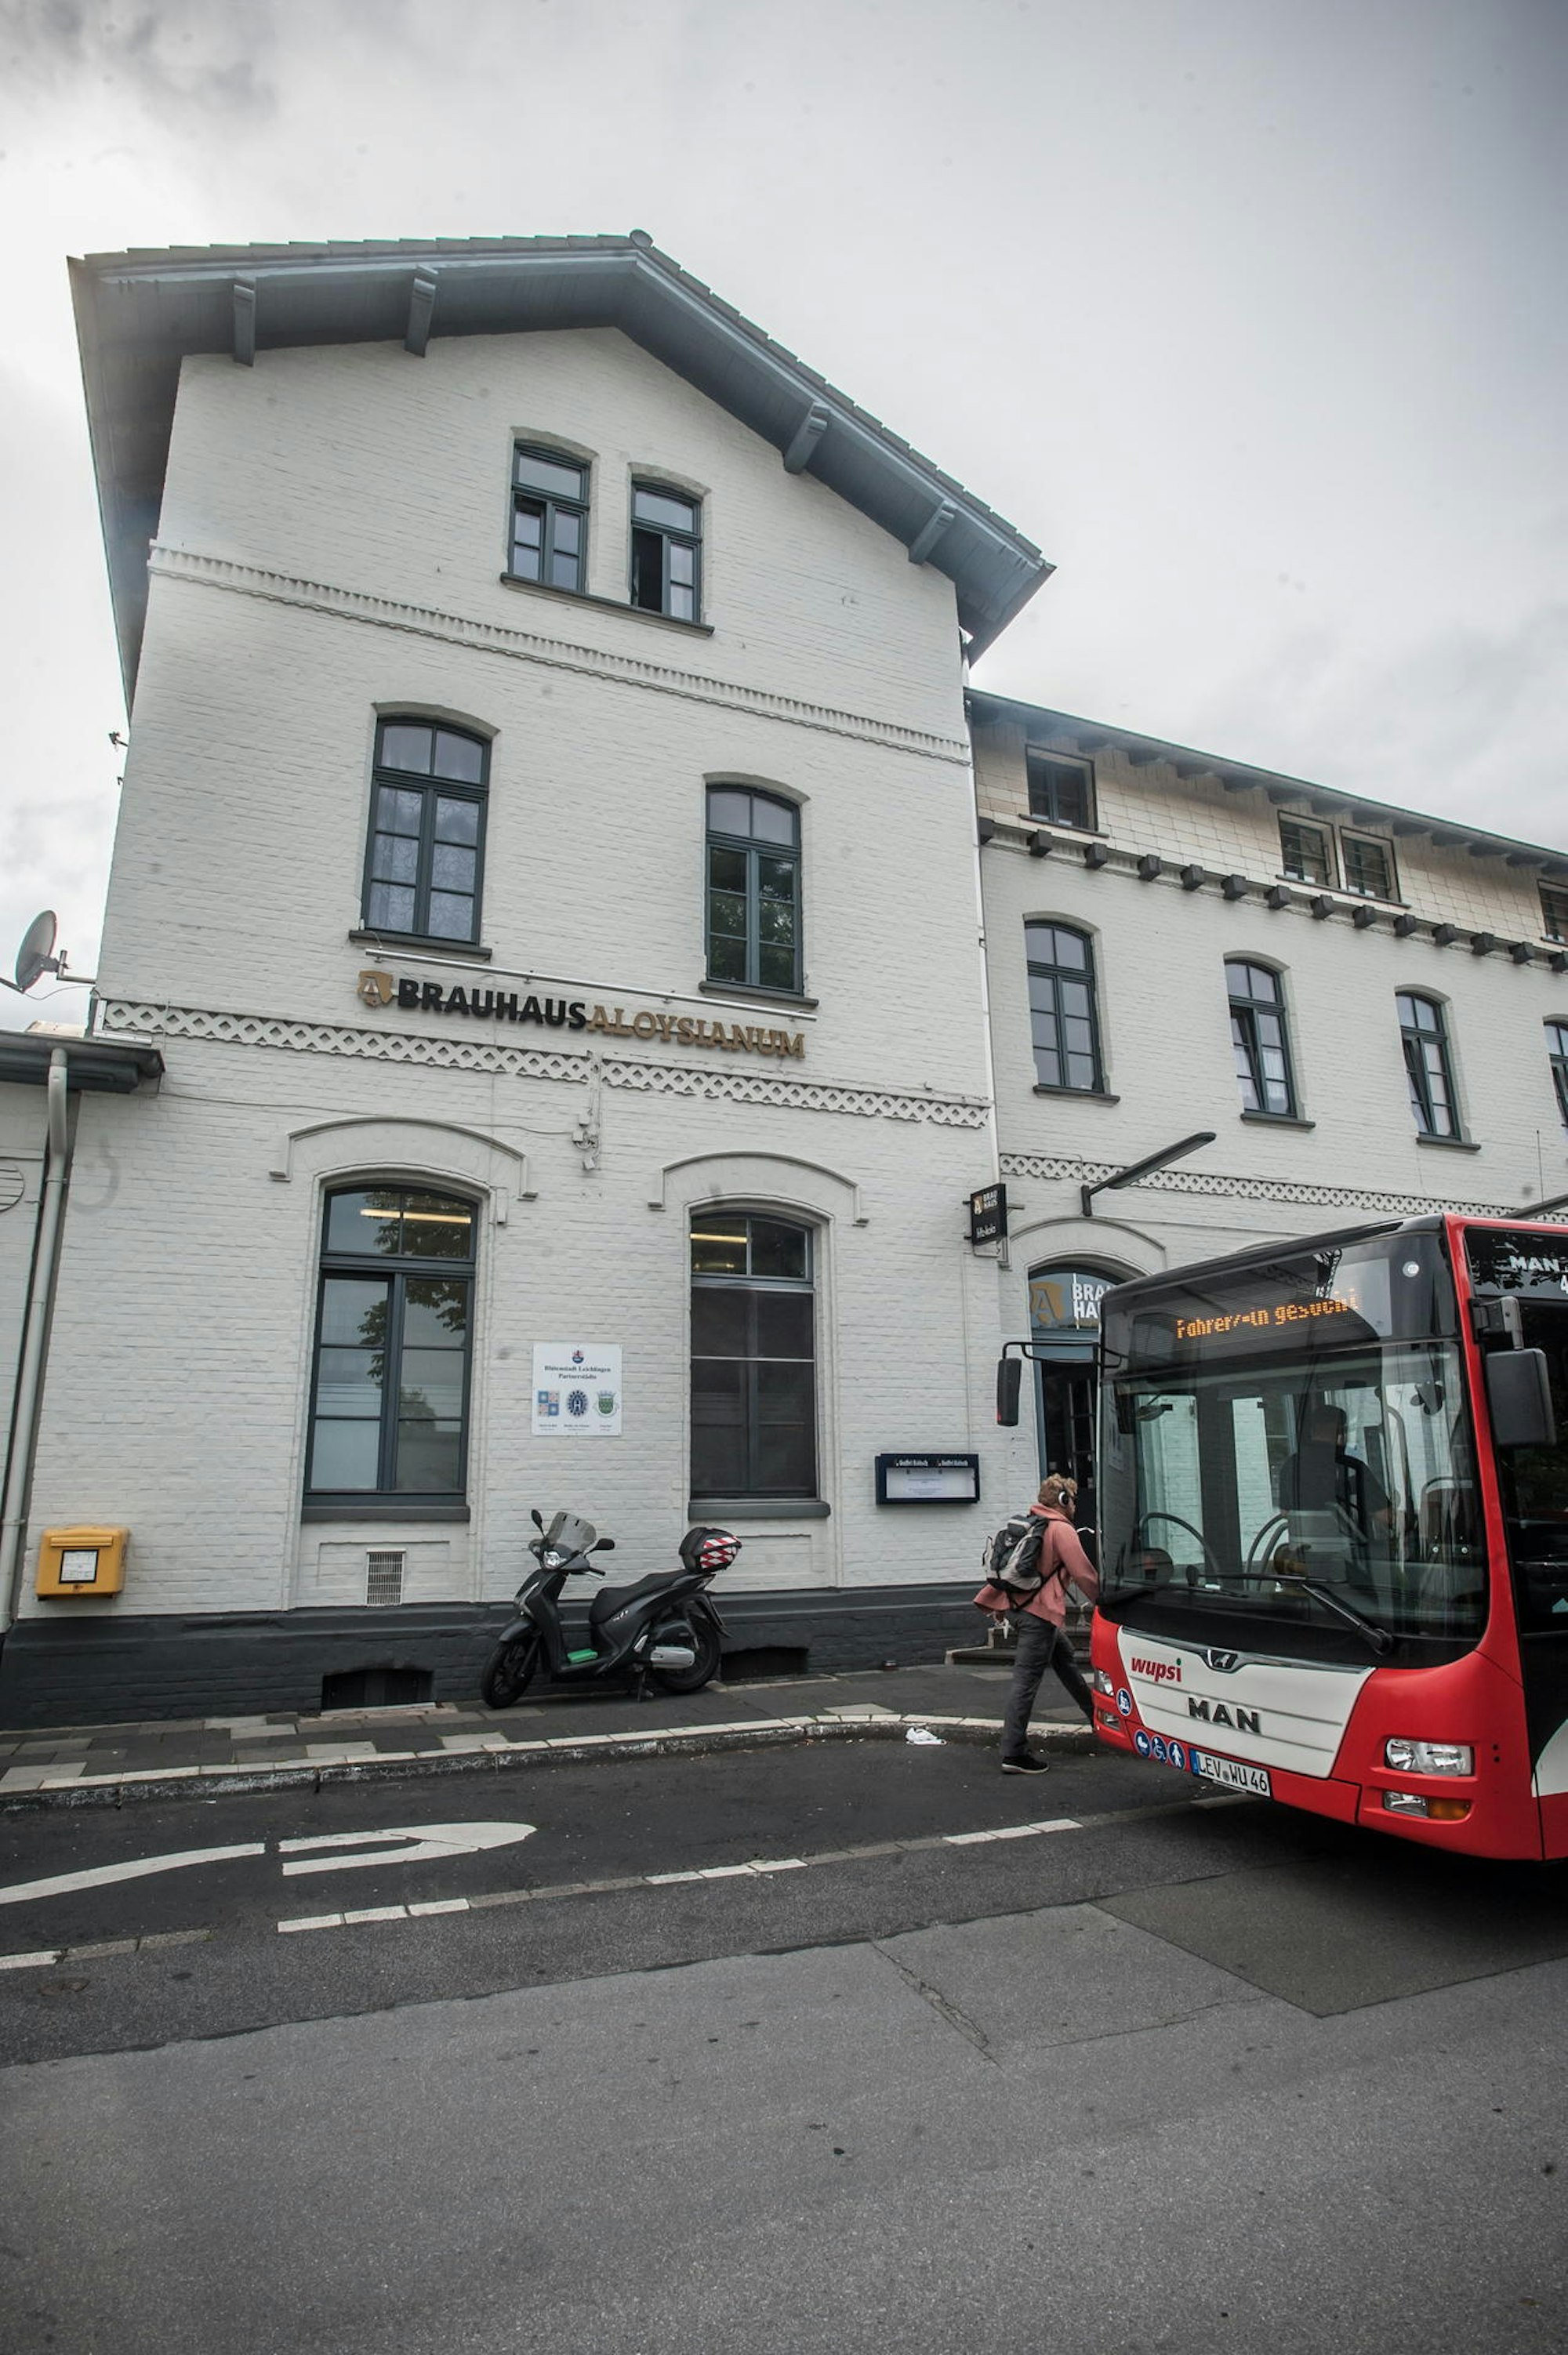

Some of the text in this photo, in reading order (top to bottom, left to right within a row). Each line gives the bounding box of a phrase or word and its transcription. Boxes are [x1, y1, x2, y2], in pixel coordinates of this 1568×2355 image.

[397, 978, 586, 1029] BRAUHAUS
[589, 1005, 805, 1058] ALOYSIANUM
[1509, 1255, 1560, 1272] MAN
[1073, 1283, 1112, 1301] BRA
[1073, 1301, 1102, 1319] HA
[1131, 1657, 1181, 1682] wupsi
[1188, 1696, 1261, 1735] MAN
[1196, 1754, 1222, 1778] LEV
[1250, 1770, 1269, 1793] 46
